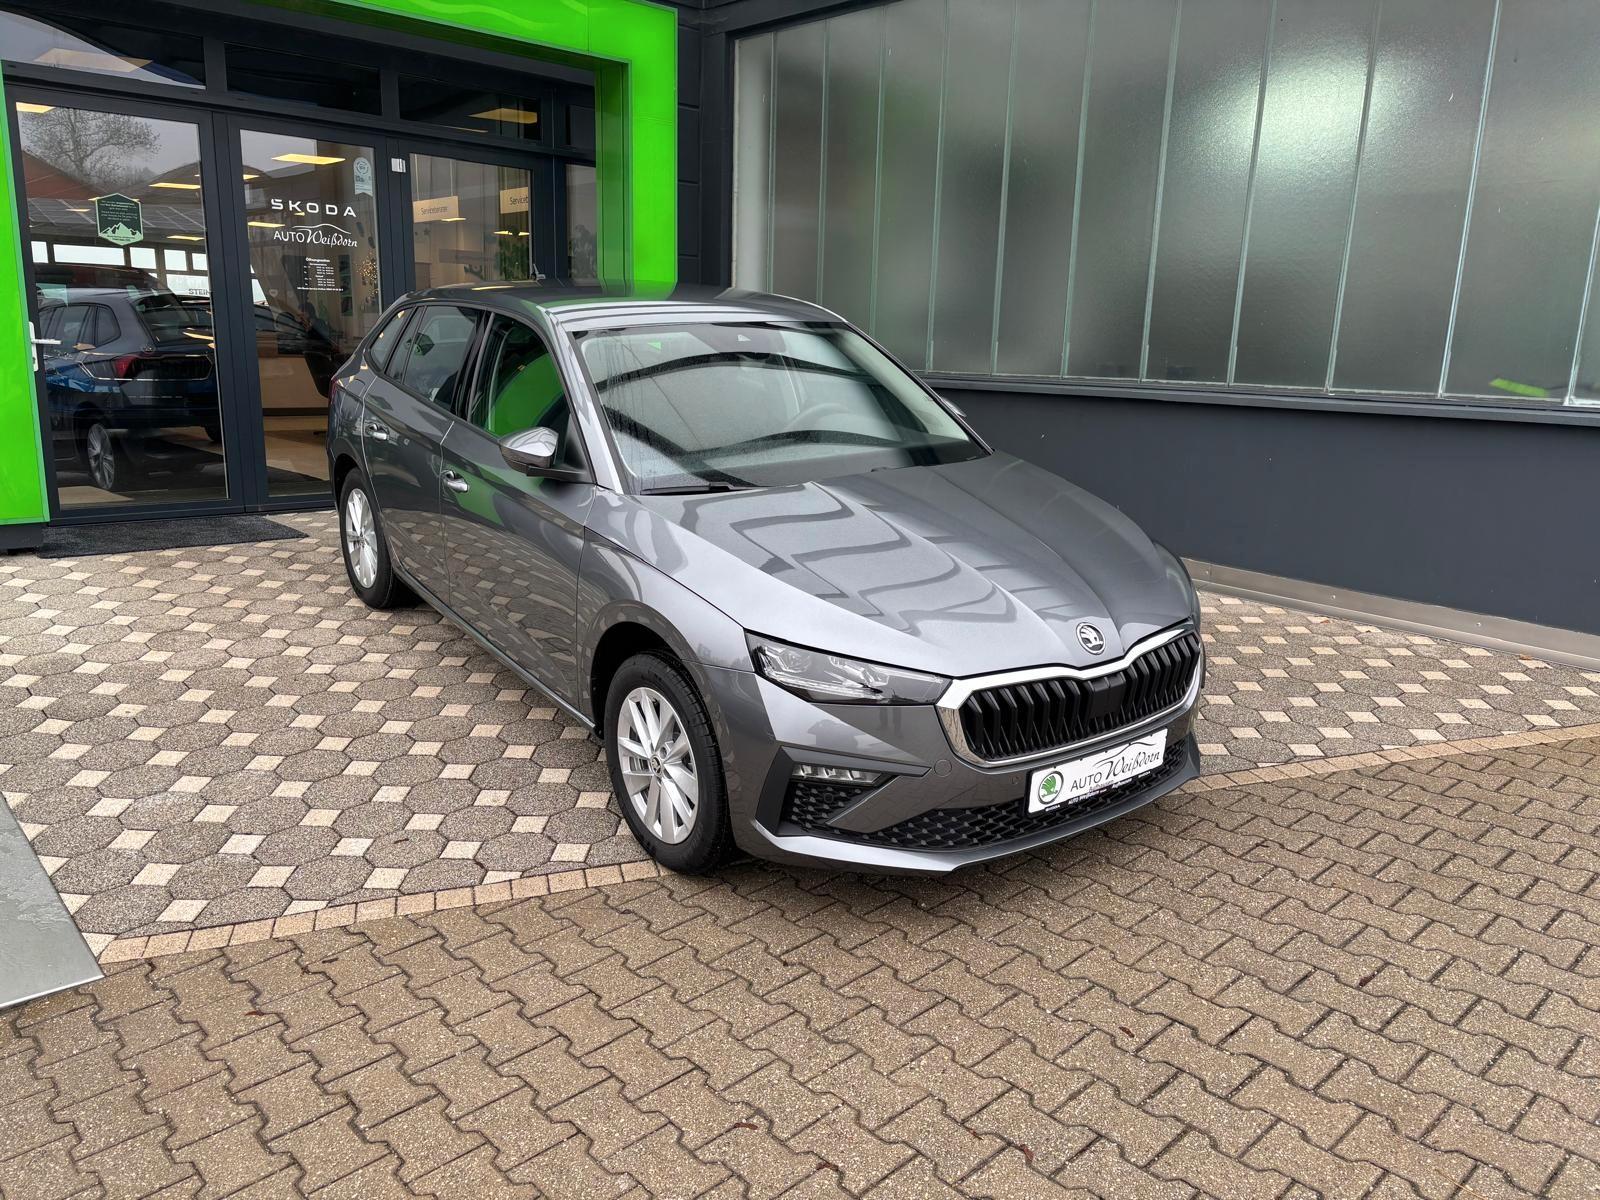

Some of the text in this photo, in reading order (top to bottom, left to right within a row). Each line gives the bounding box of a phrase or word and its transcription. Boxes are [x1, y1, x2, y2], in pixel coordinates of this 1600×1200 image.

[273, 228, 358, 248] AUTO Weißdorn
[1070, 751, 1160, 792] AUTO Weißdorn
